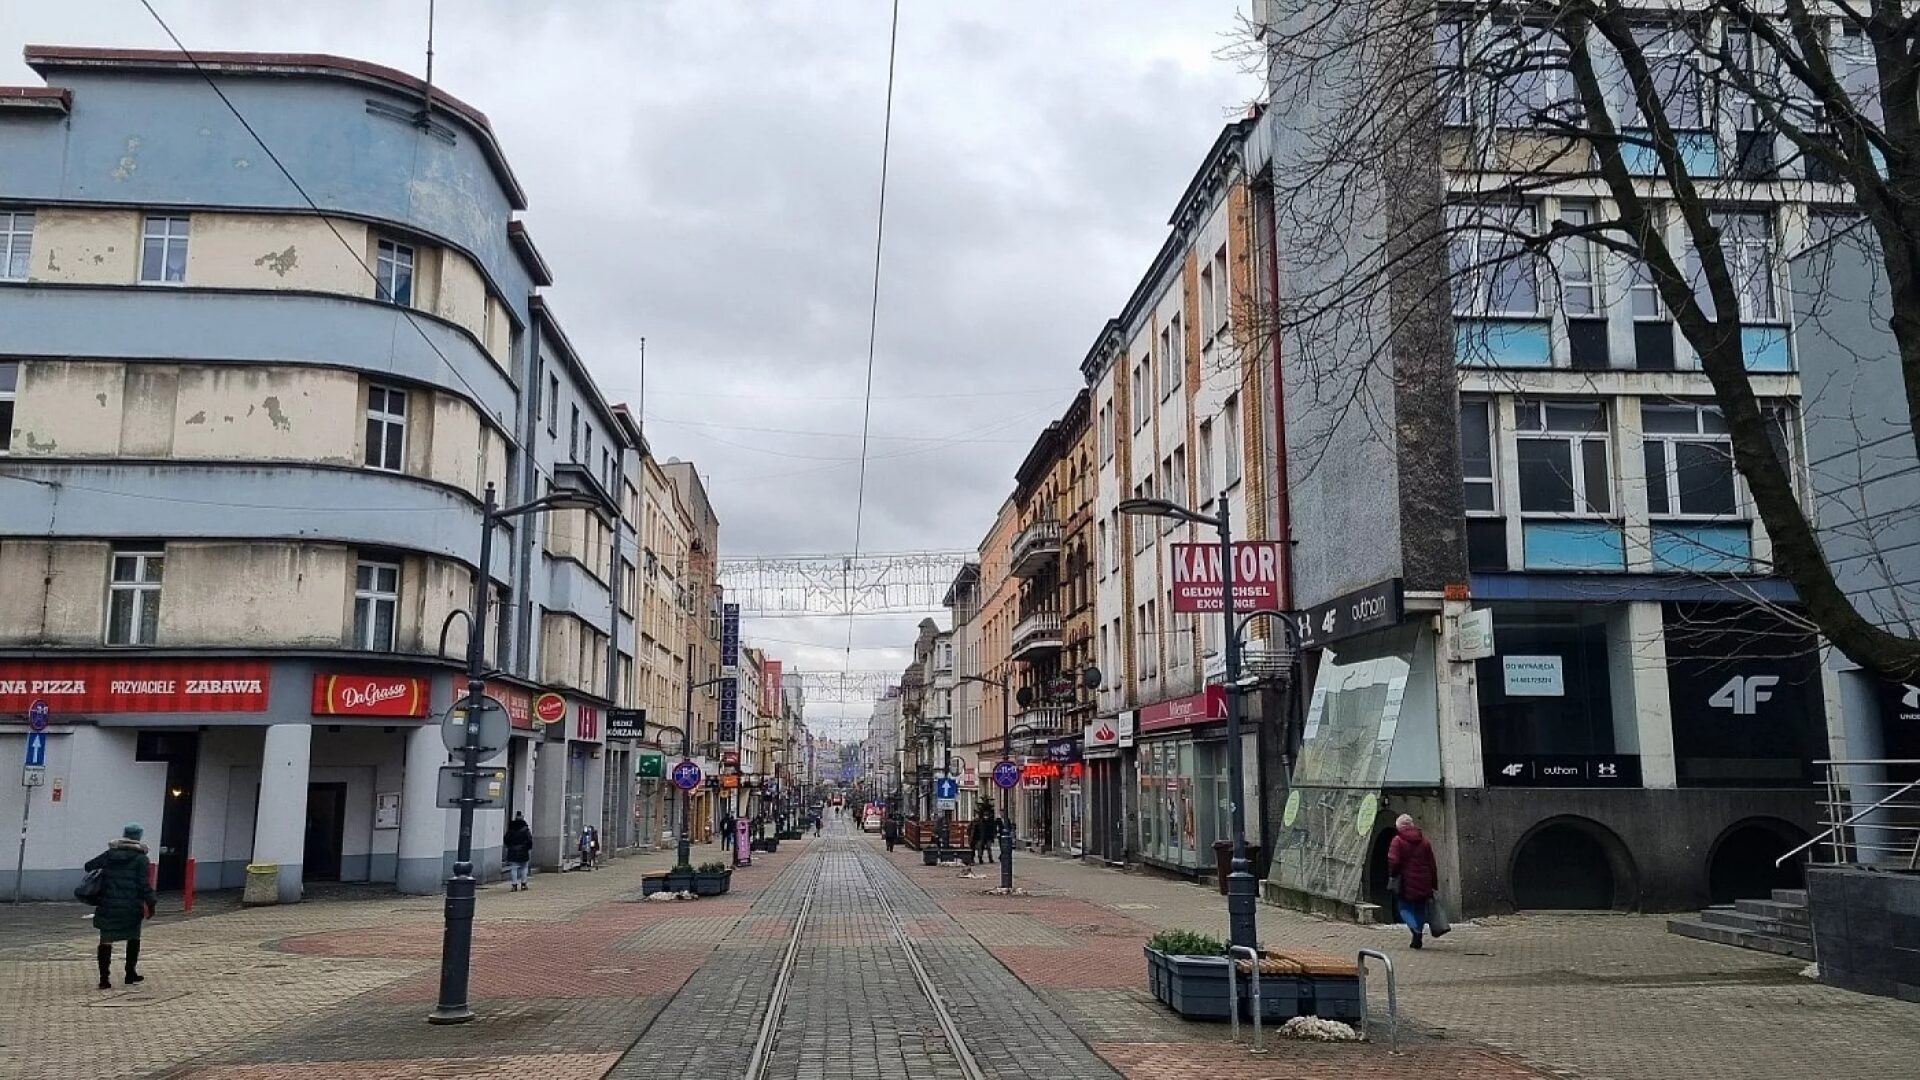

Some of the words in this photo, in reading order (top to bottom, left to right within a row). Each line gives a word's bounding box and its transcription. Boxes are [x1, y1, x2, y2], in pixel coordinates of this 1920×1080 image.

[1174, 545, 1275, 583] KANTOR
[1181, 586, 1270, 597] GELDWCHSEL
[1196, 598, 1256, 609] EXCHNGE
[1321, 608, 1337, 634] 4F
[31, 680, 86, 694] PIZZA
[111, 680, 177, 694] PRZYJACIELE
[185, 680, 262, 694] ZABAWA
[1708, 675, 1780, 715] 4F
[1502, 763, 1524, 776] 4F
